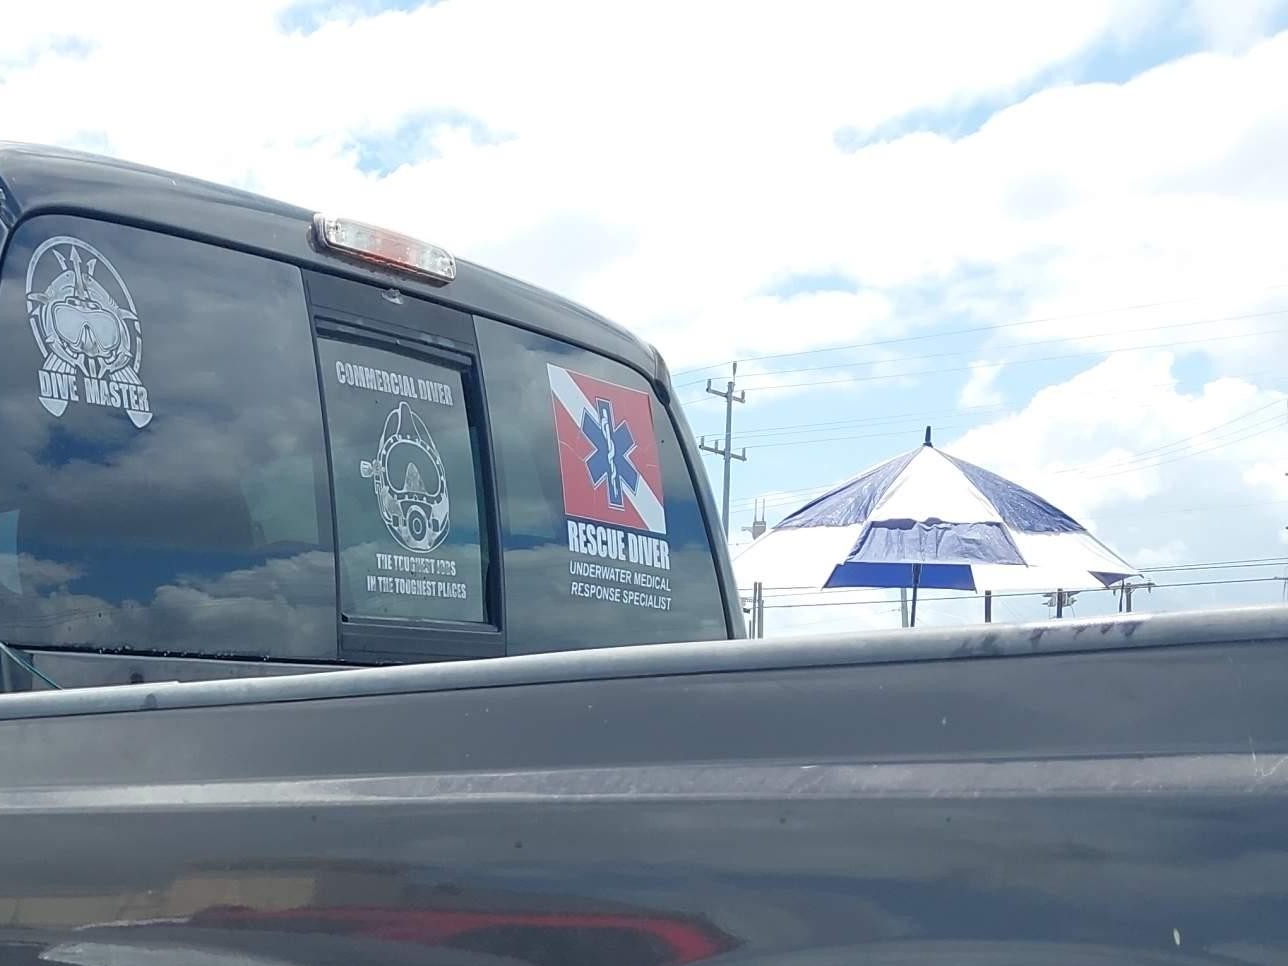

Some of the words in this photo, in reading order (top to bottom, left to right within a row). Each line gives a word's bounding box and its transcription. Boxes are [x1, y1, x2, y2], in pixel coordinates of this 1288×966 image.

[38, 370, 79, 400] DIVE
[84, 377, 150, 411] MASTER
[335, 361, 417, 399] COMMERCIAL
[417, 379, 454, 406] DIVER
[567, 520, 626, 561] RESCUE
[628, 534, 670, 570] DIVER
[376, 553, 393, 570] THE
[393, 555, 435, 574] TOUGHEST
[569, 560, 632, 583] UNDERWATER
[633, 570, 671, 591] MEDICAL
[367, 575, 377, 592] IN
[377, 576, 394, 593] THE
[394, 577, 437, 597] TOUGHEST
[437, 581, 467, 599] PLACES
[570, 582, 621, 602] RESPONSE
[622, 589, 672, 611] SPECIALIST
